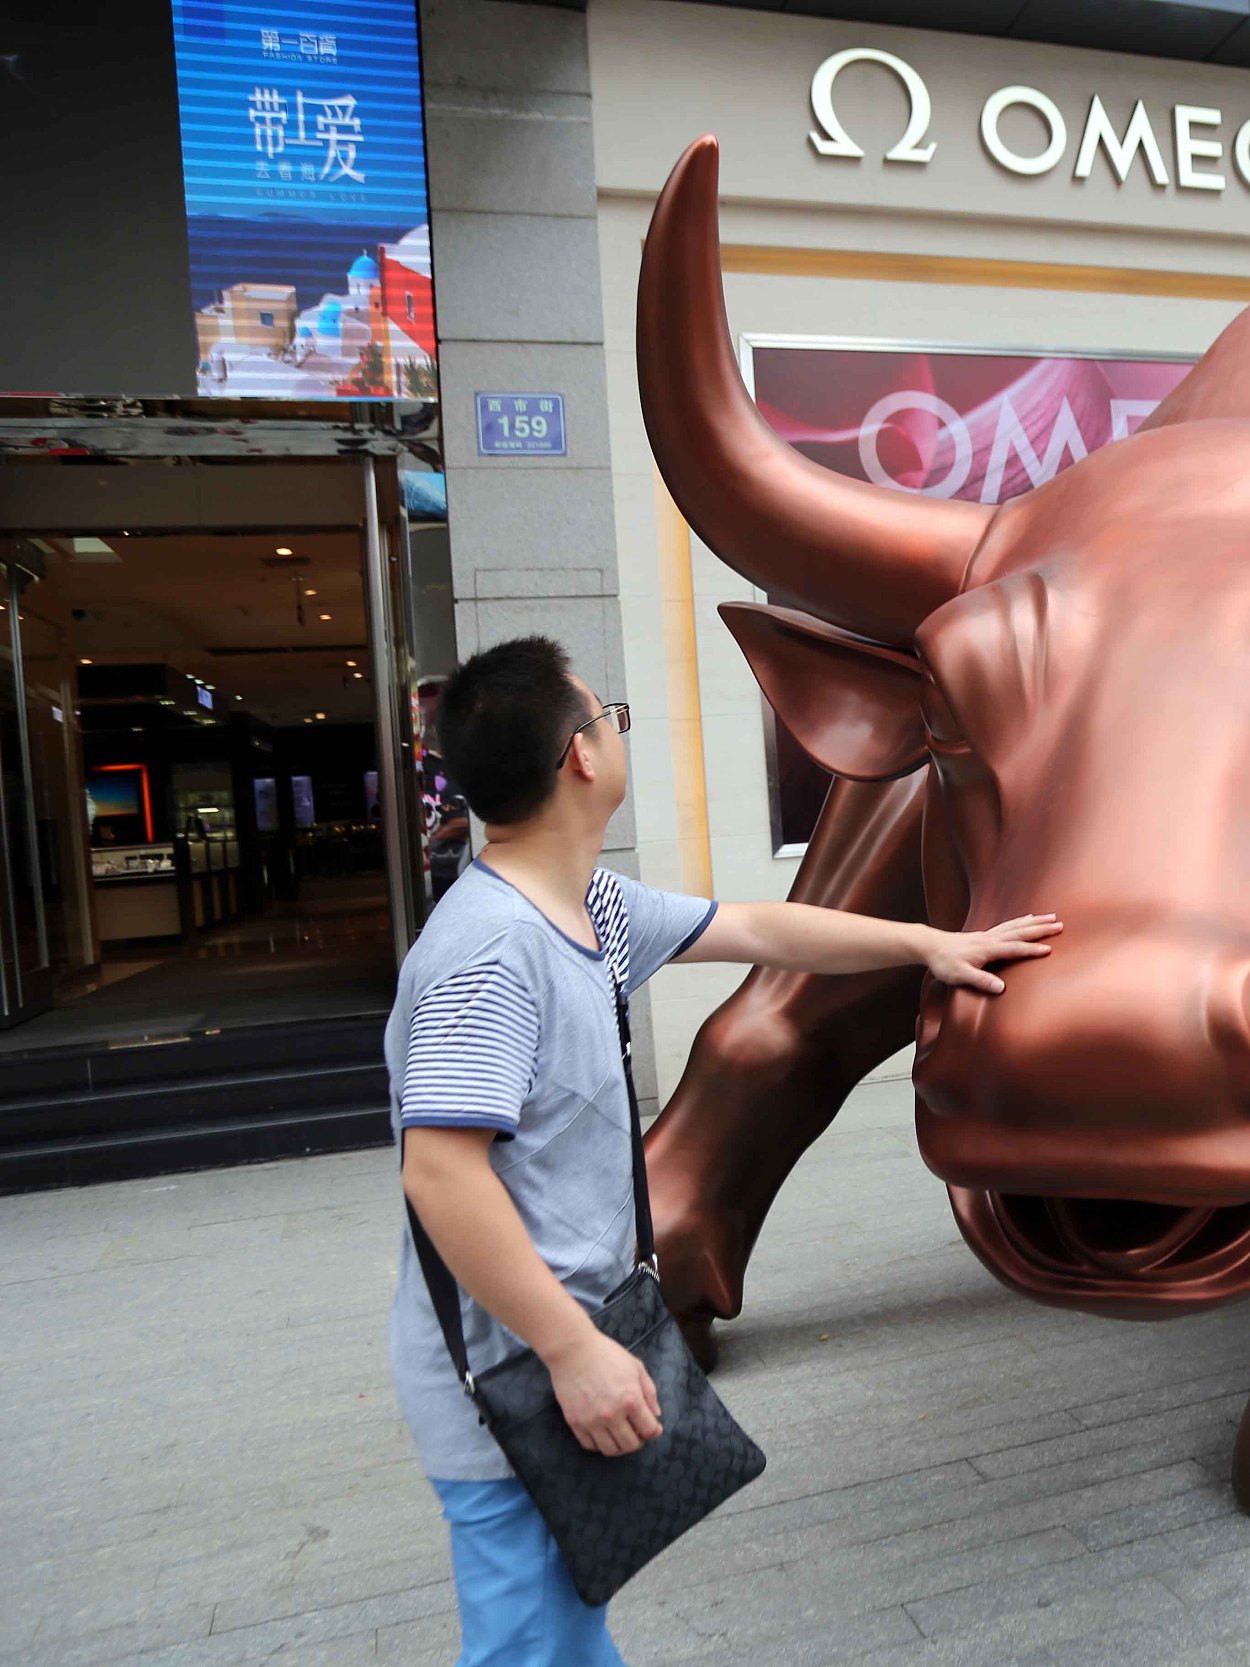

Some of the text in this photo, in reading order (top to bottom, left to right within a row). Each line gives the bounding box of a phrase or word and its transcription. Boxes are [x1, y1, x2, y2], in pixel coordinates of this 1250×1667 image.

[306, 54, 338, 65] STORE
[248, 86, 366, 184] 带上爱
[498, 415, 548, 438] 159
